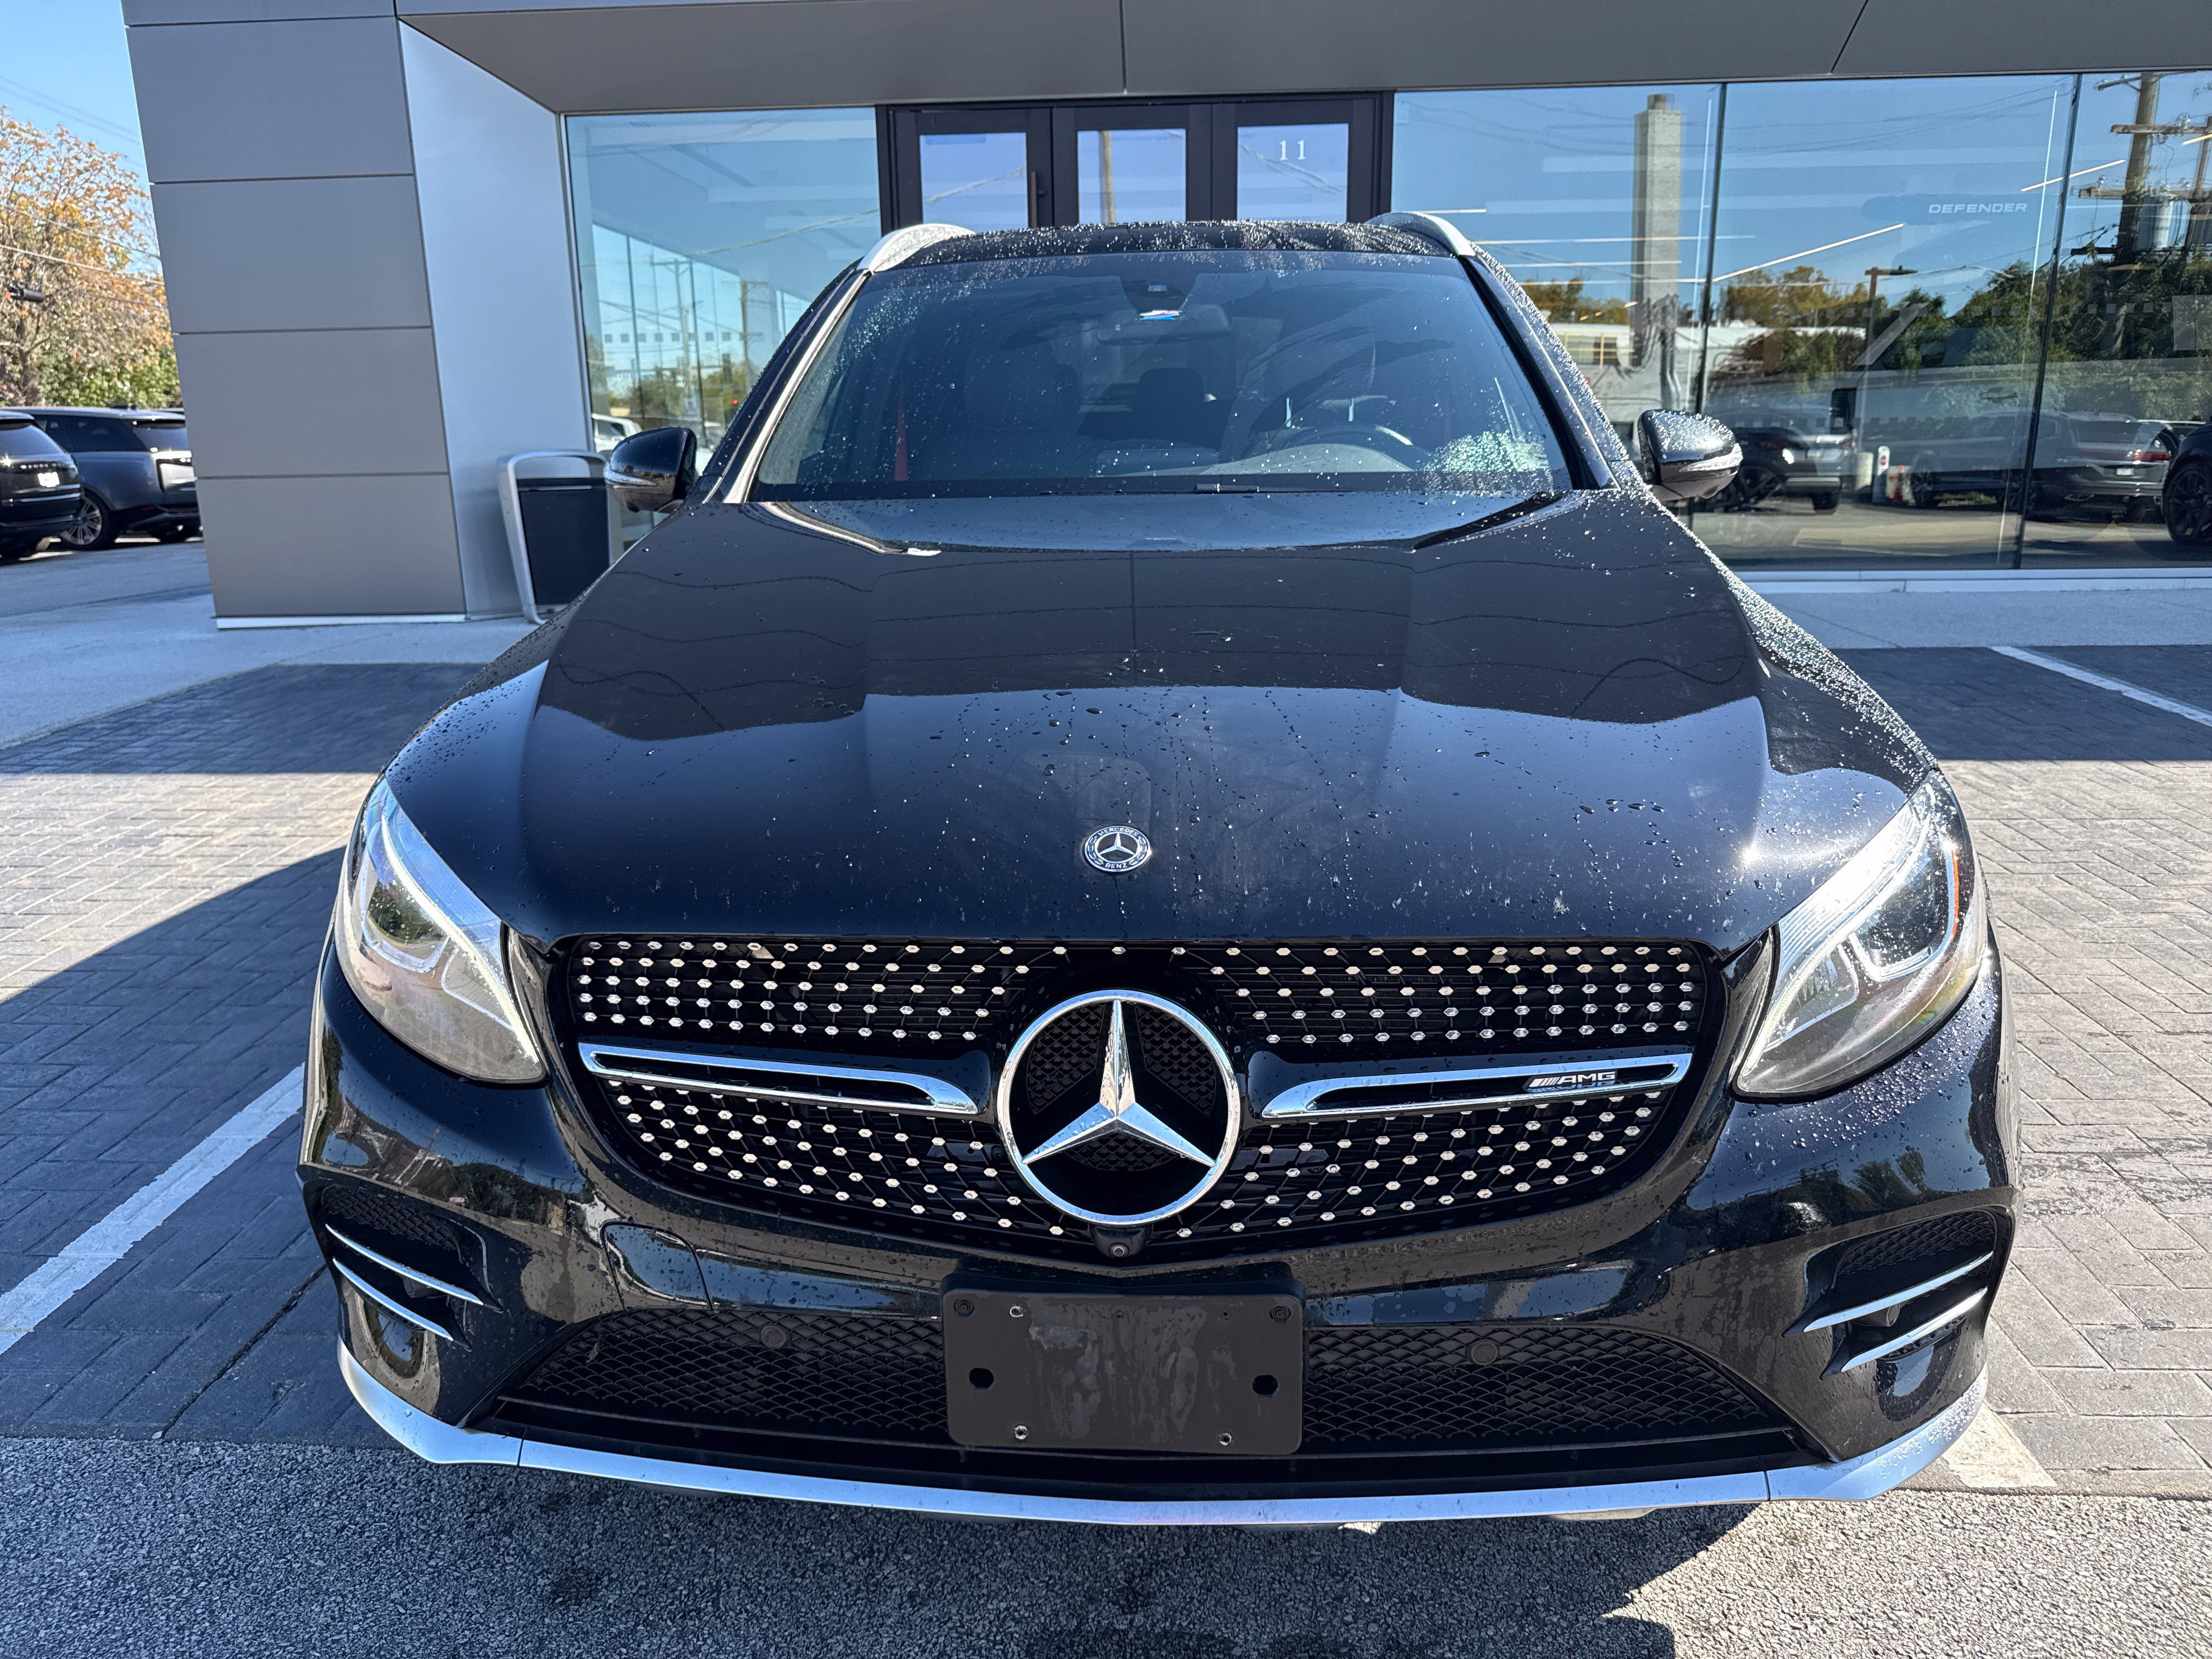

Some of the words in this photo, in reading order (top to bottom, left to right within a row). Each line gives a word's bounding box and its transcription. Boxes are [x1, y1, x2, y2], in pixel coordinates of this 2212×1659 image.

[1279, 139, 1306, 160] 11
[1928, 203, 2028, 213] DEFENDER
[1098, 827, 1139, 837] MERCEDES
